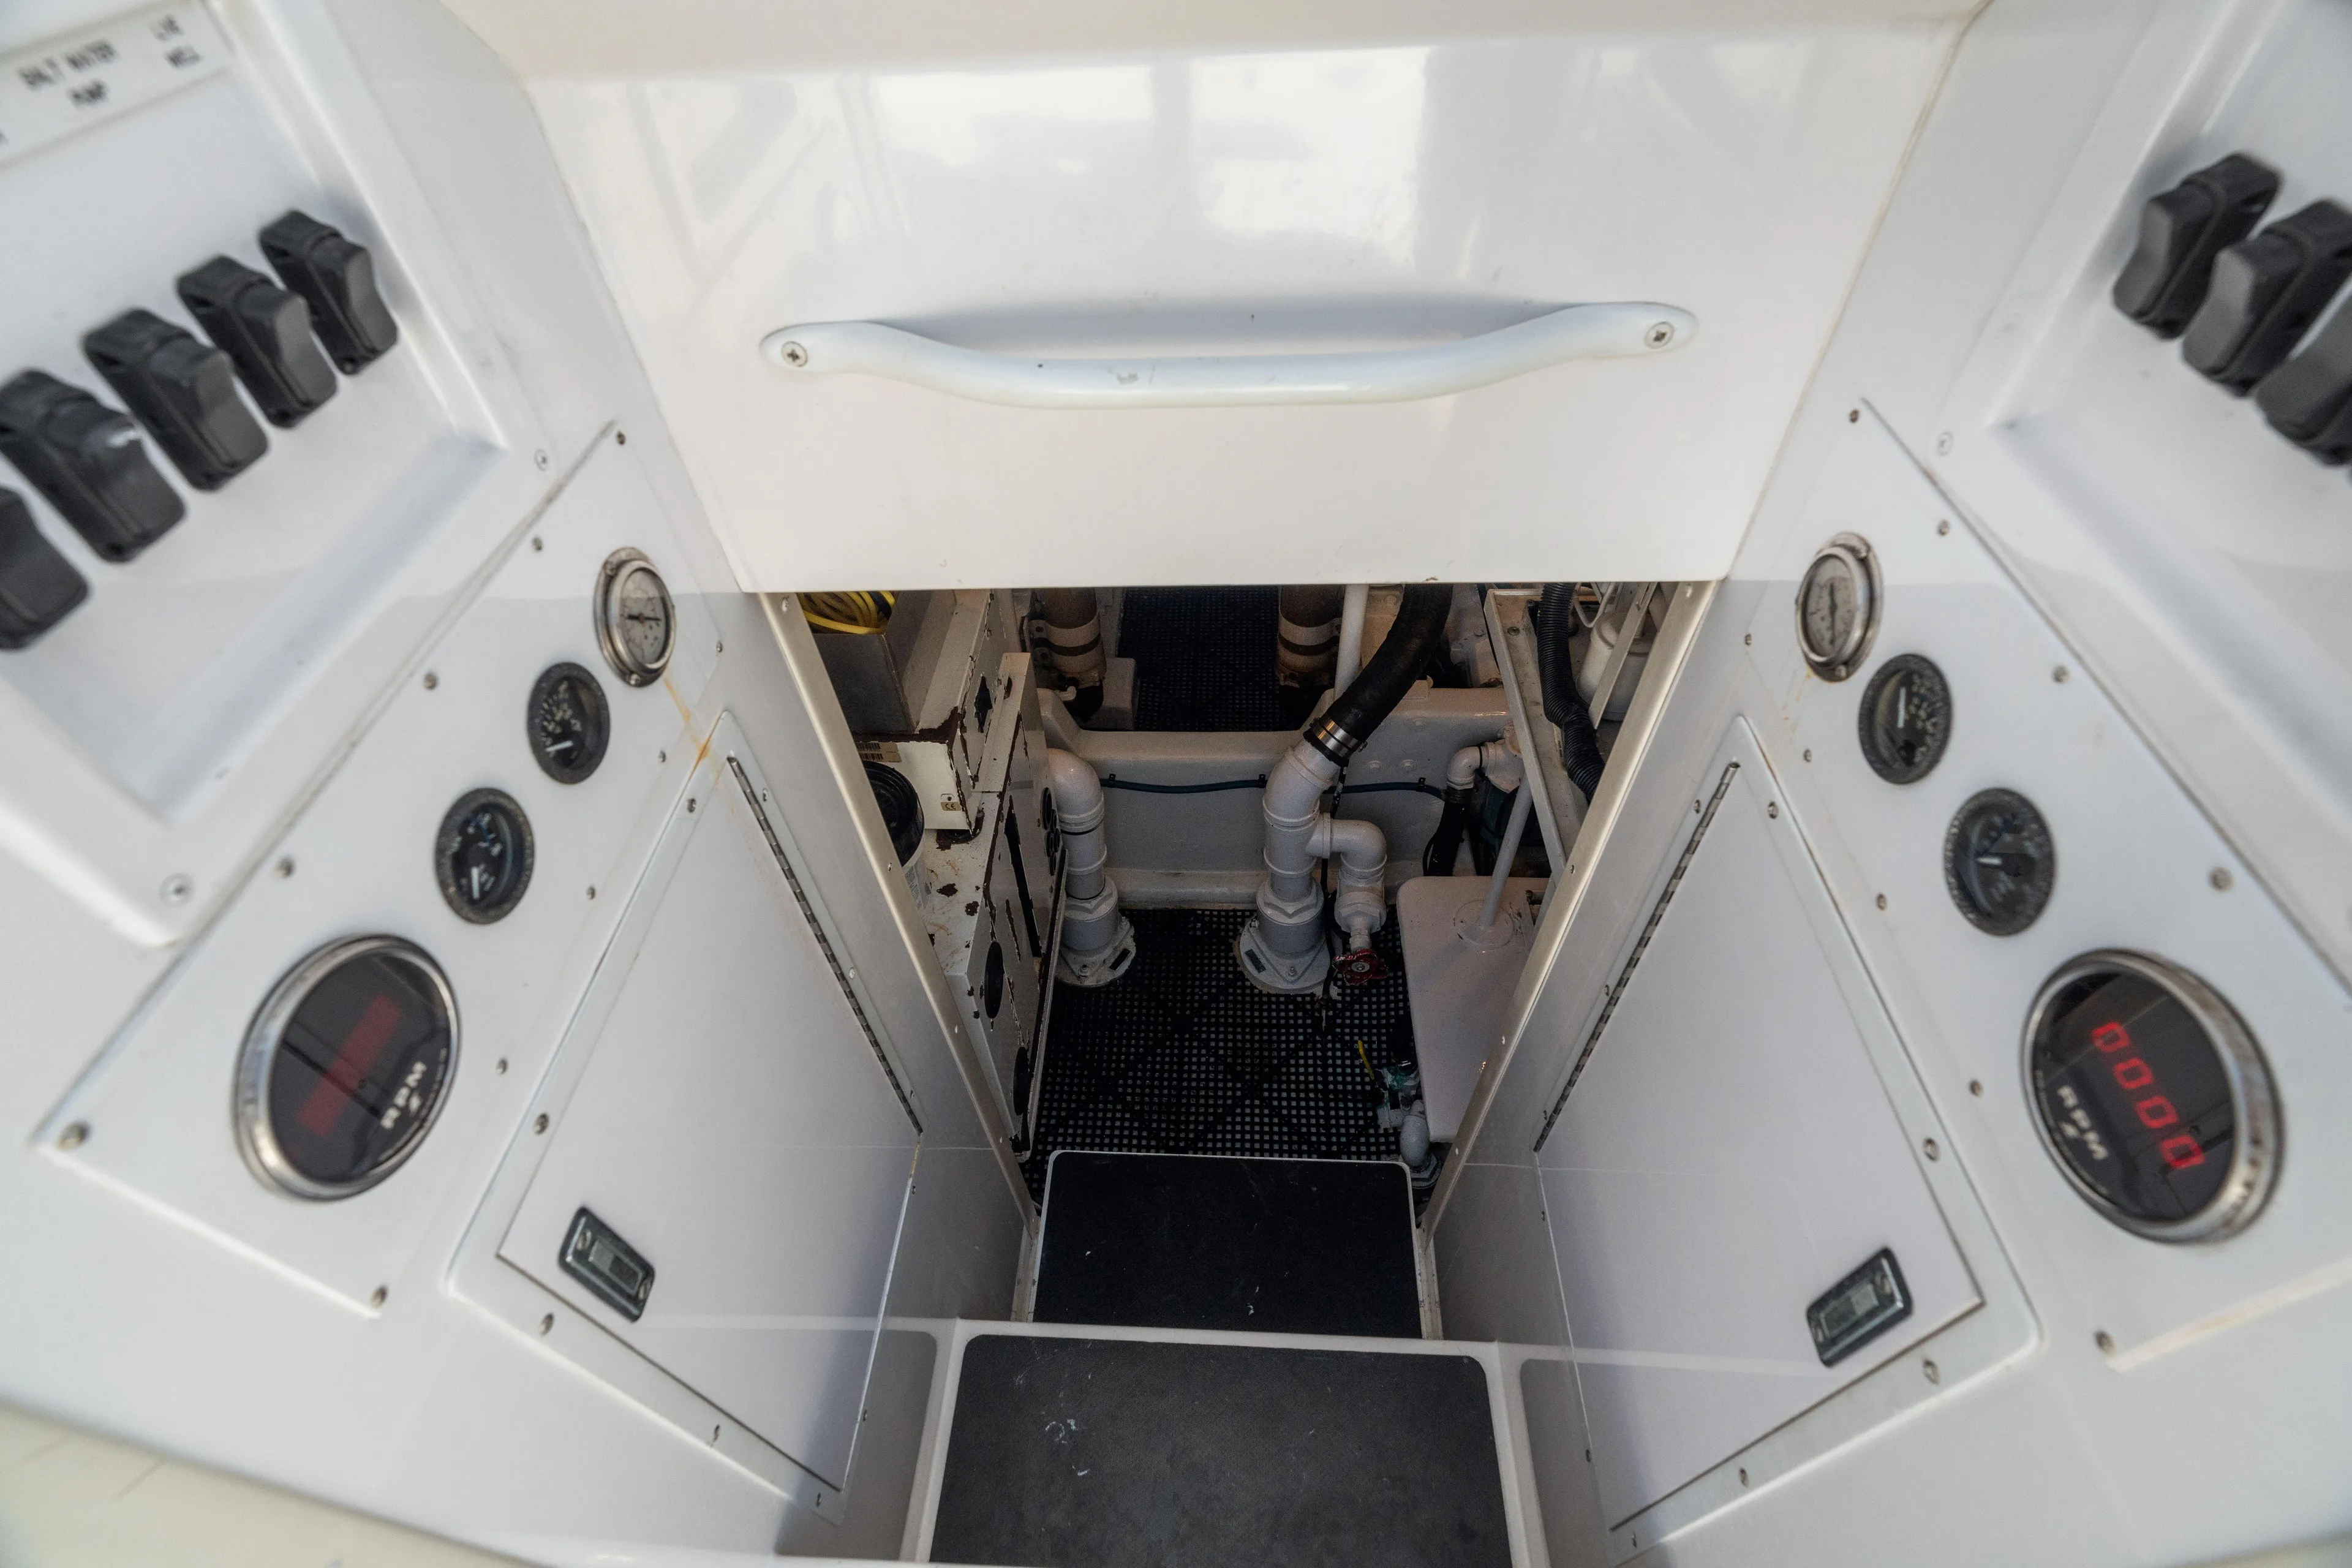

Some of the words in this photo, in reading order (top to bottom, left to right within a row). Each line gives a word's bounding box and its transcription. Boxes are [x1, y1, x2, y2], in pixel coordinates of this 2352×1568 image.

[17, 57, 64, 90] SALT
[65, 39, 118, 70] WATER
[67, 78, 108, 107] PUMP
[380, 1061, 426, 1129] RPM
[2056, 1085, 2109, 1161] RPM
[2092, 1022, 2205, 1169] 0000
